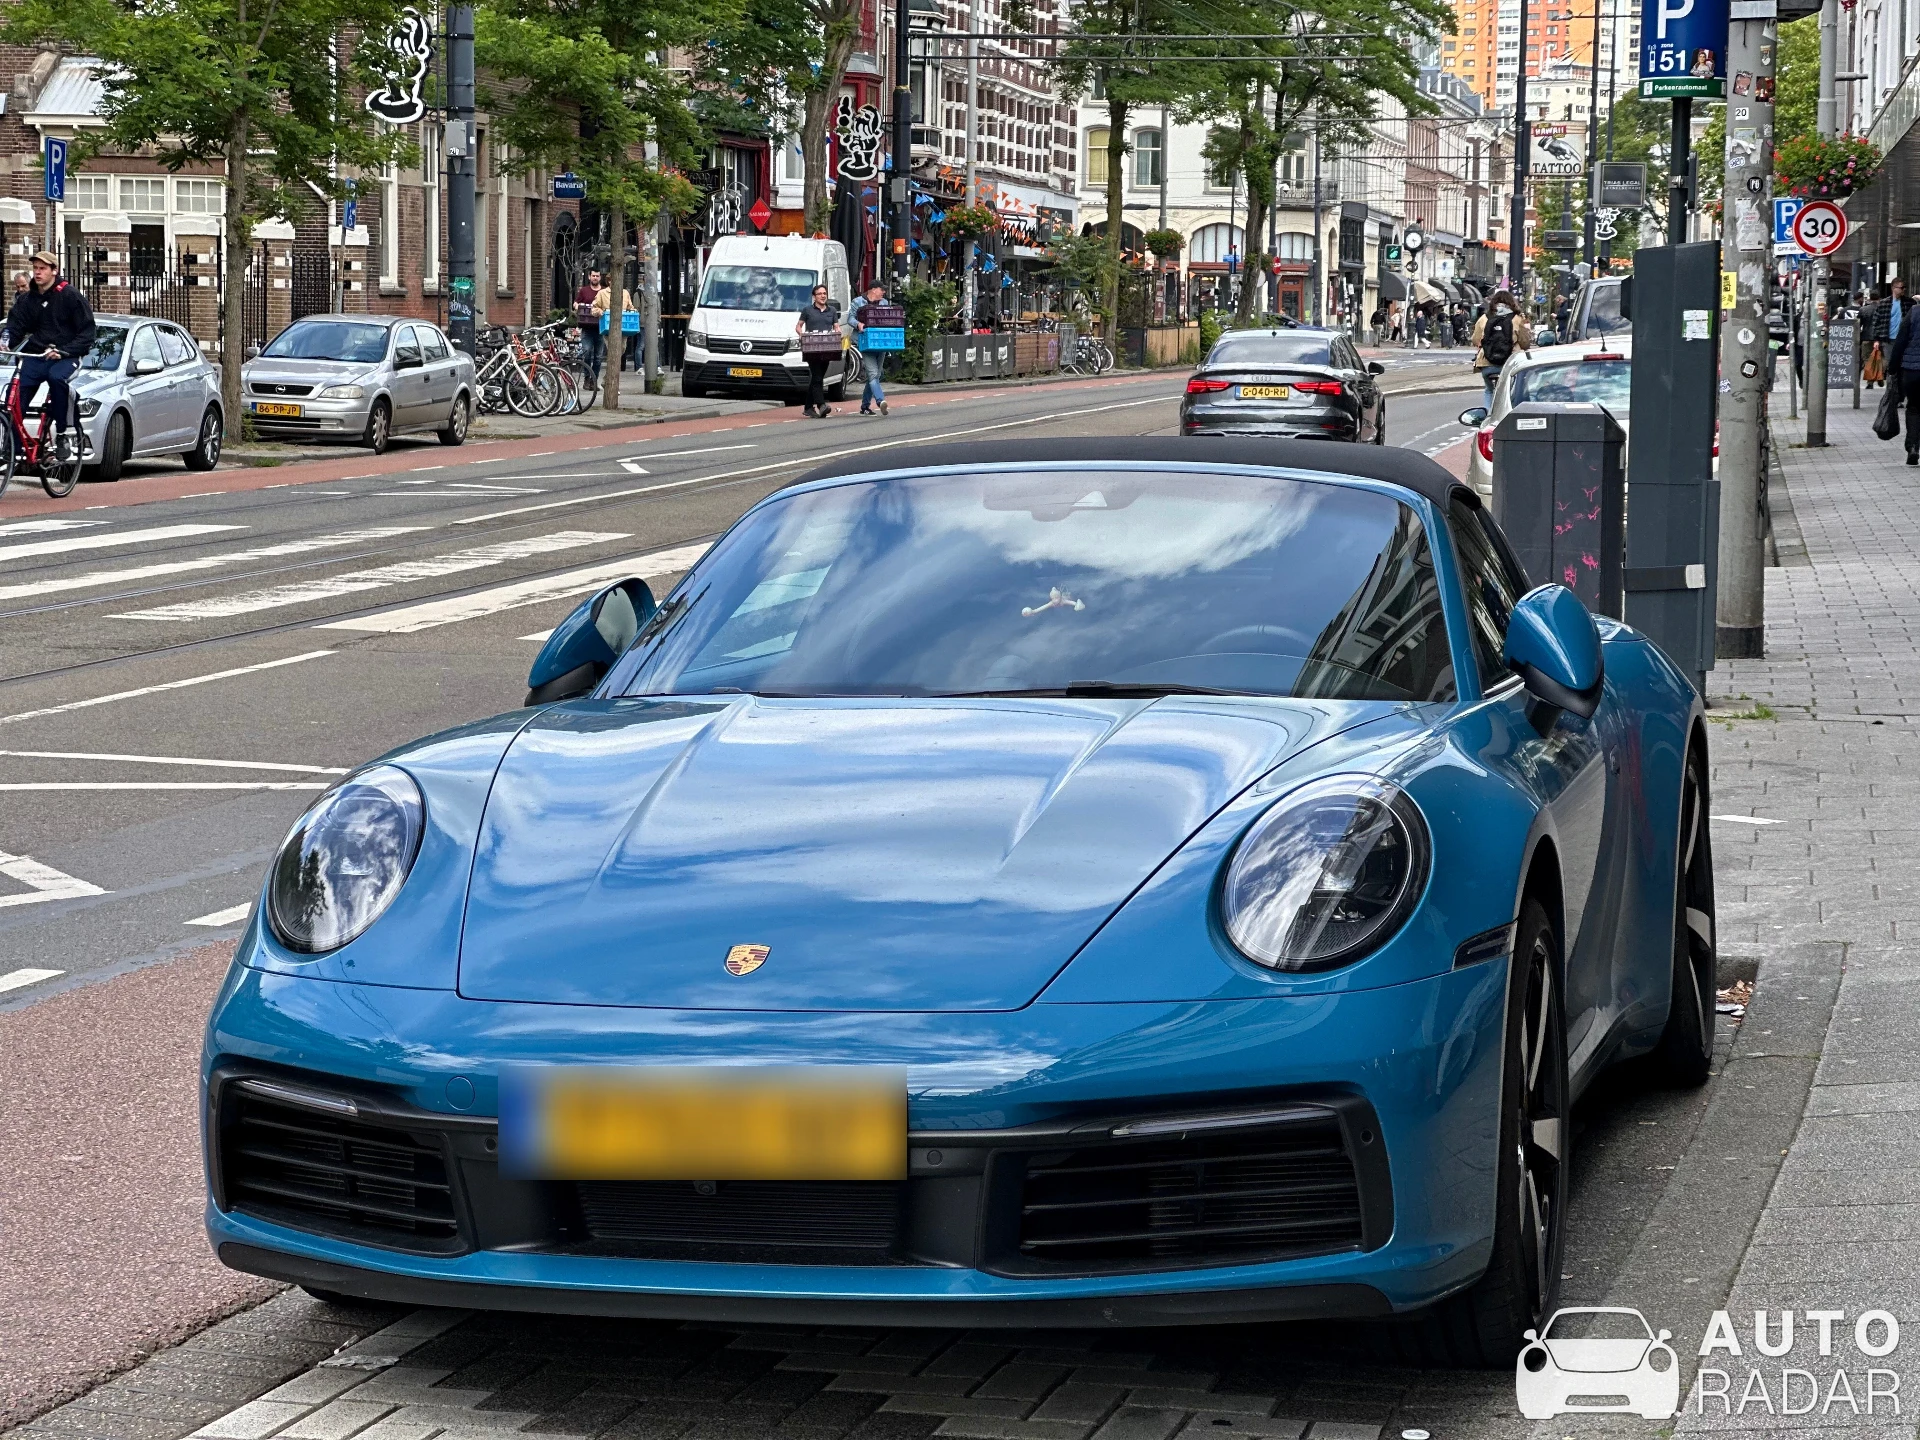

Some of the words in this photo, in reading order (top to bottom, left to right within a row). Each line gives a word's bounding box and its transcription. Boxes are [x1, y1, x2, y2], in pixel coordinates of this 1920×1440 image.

[1657, 0, 1695, 39] P
[1660, 50, 1686, 71] 51
[1736, 109, 1747, 117] 20
[1535, 126, 1564, 136] HAWAII
[52, 144, 62, 174] P
[1532, 163, 1582, 173] TATTOO
[555, 181, 584, 189] Bavaria
[1781, 203, 1797, 224] P
[1804, 218, 1837, 238] 30
[1242, 388, 1287, 398] G-040-RH
[259, 404, 297, 414] 86-DP-JP
